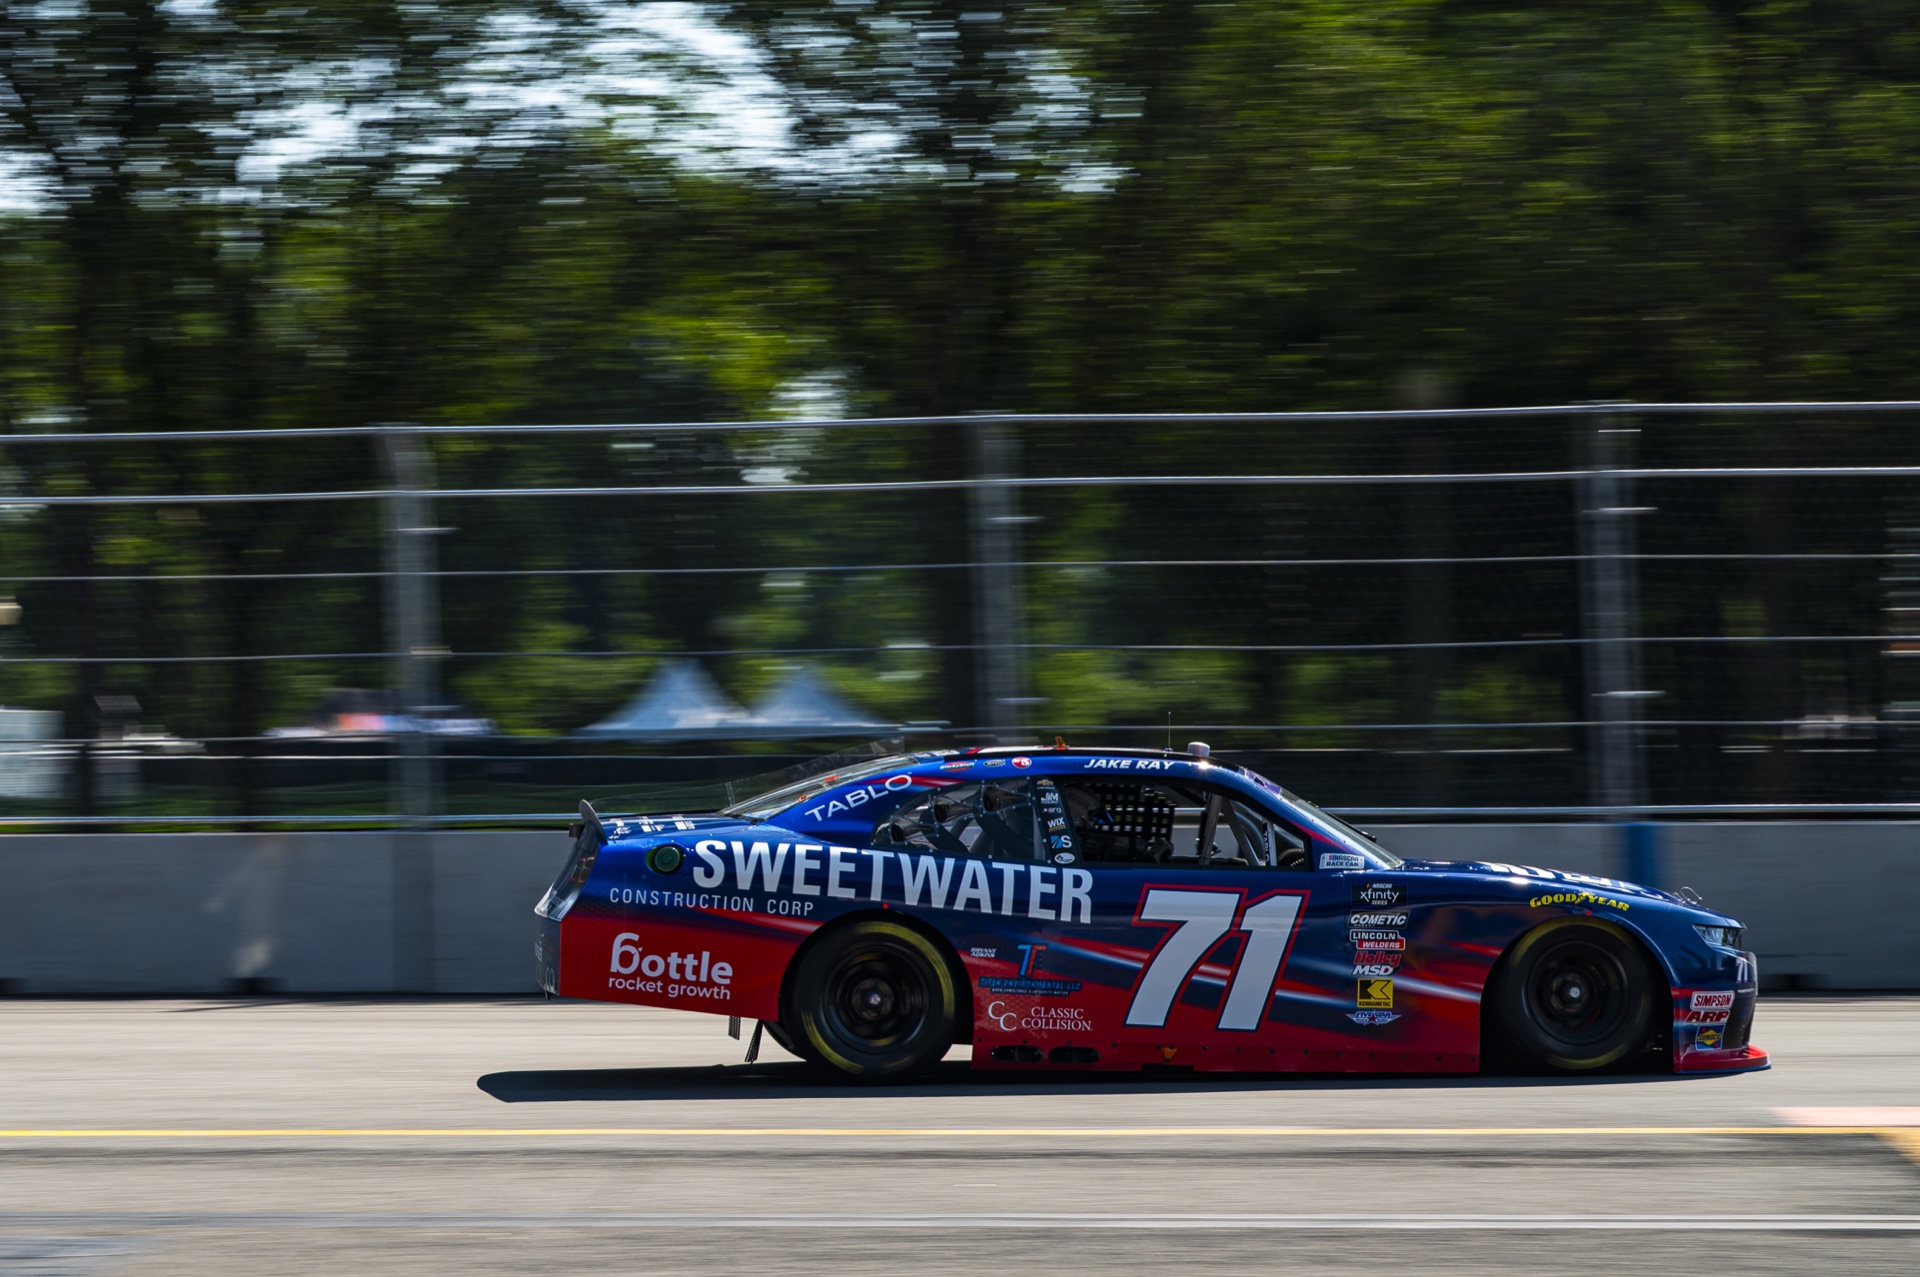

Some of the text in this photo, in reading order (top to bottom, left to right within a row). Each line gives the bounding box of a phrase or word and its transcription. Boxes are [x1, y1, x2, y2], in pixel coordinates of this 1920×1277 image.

[1084, 759, 1175, 770] JAKE RAY
[804, 774, 912, 822] TABLO
[1047, 817, 1065, 828] WIX
[692, 840, 1094, 924] SWEETWATER
[609, 887, 815, 917] CONSTRUCTION CORP
[1360, 888, 1400, 903] xfinity
[1529, 891, 1630, 912] GOODYEAR
[1350, 914, 1407, 925] COMETIC
[1352, 932, 1396, 940] LINCOLN
[1124, 888, 1304, 1031] 71
[1354, 951, 1401, 967] Holley
[1352, 965, 1394, 976] MSD
[608, 976, 731, 1000] rocket growth
[1694, 993, 1732, 1007] SIMPSON
[1031, 1007, 1085, 1019] CLASSIC
[1685, 1010, 1728, 1023] ARP
